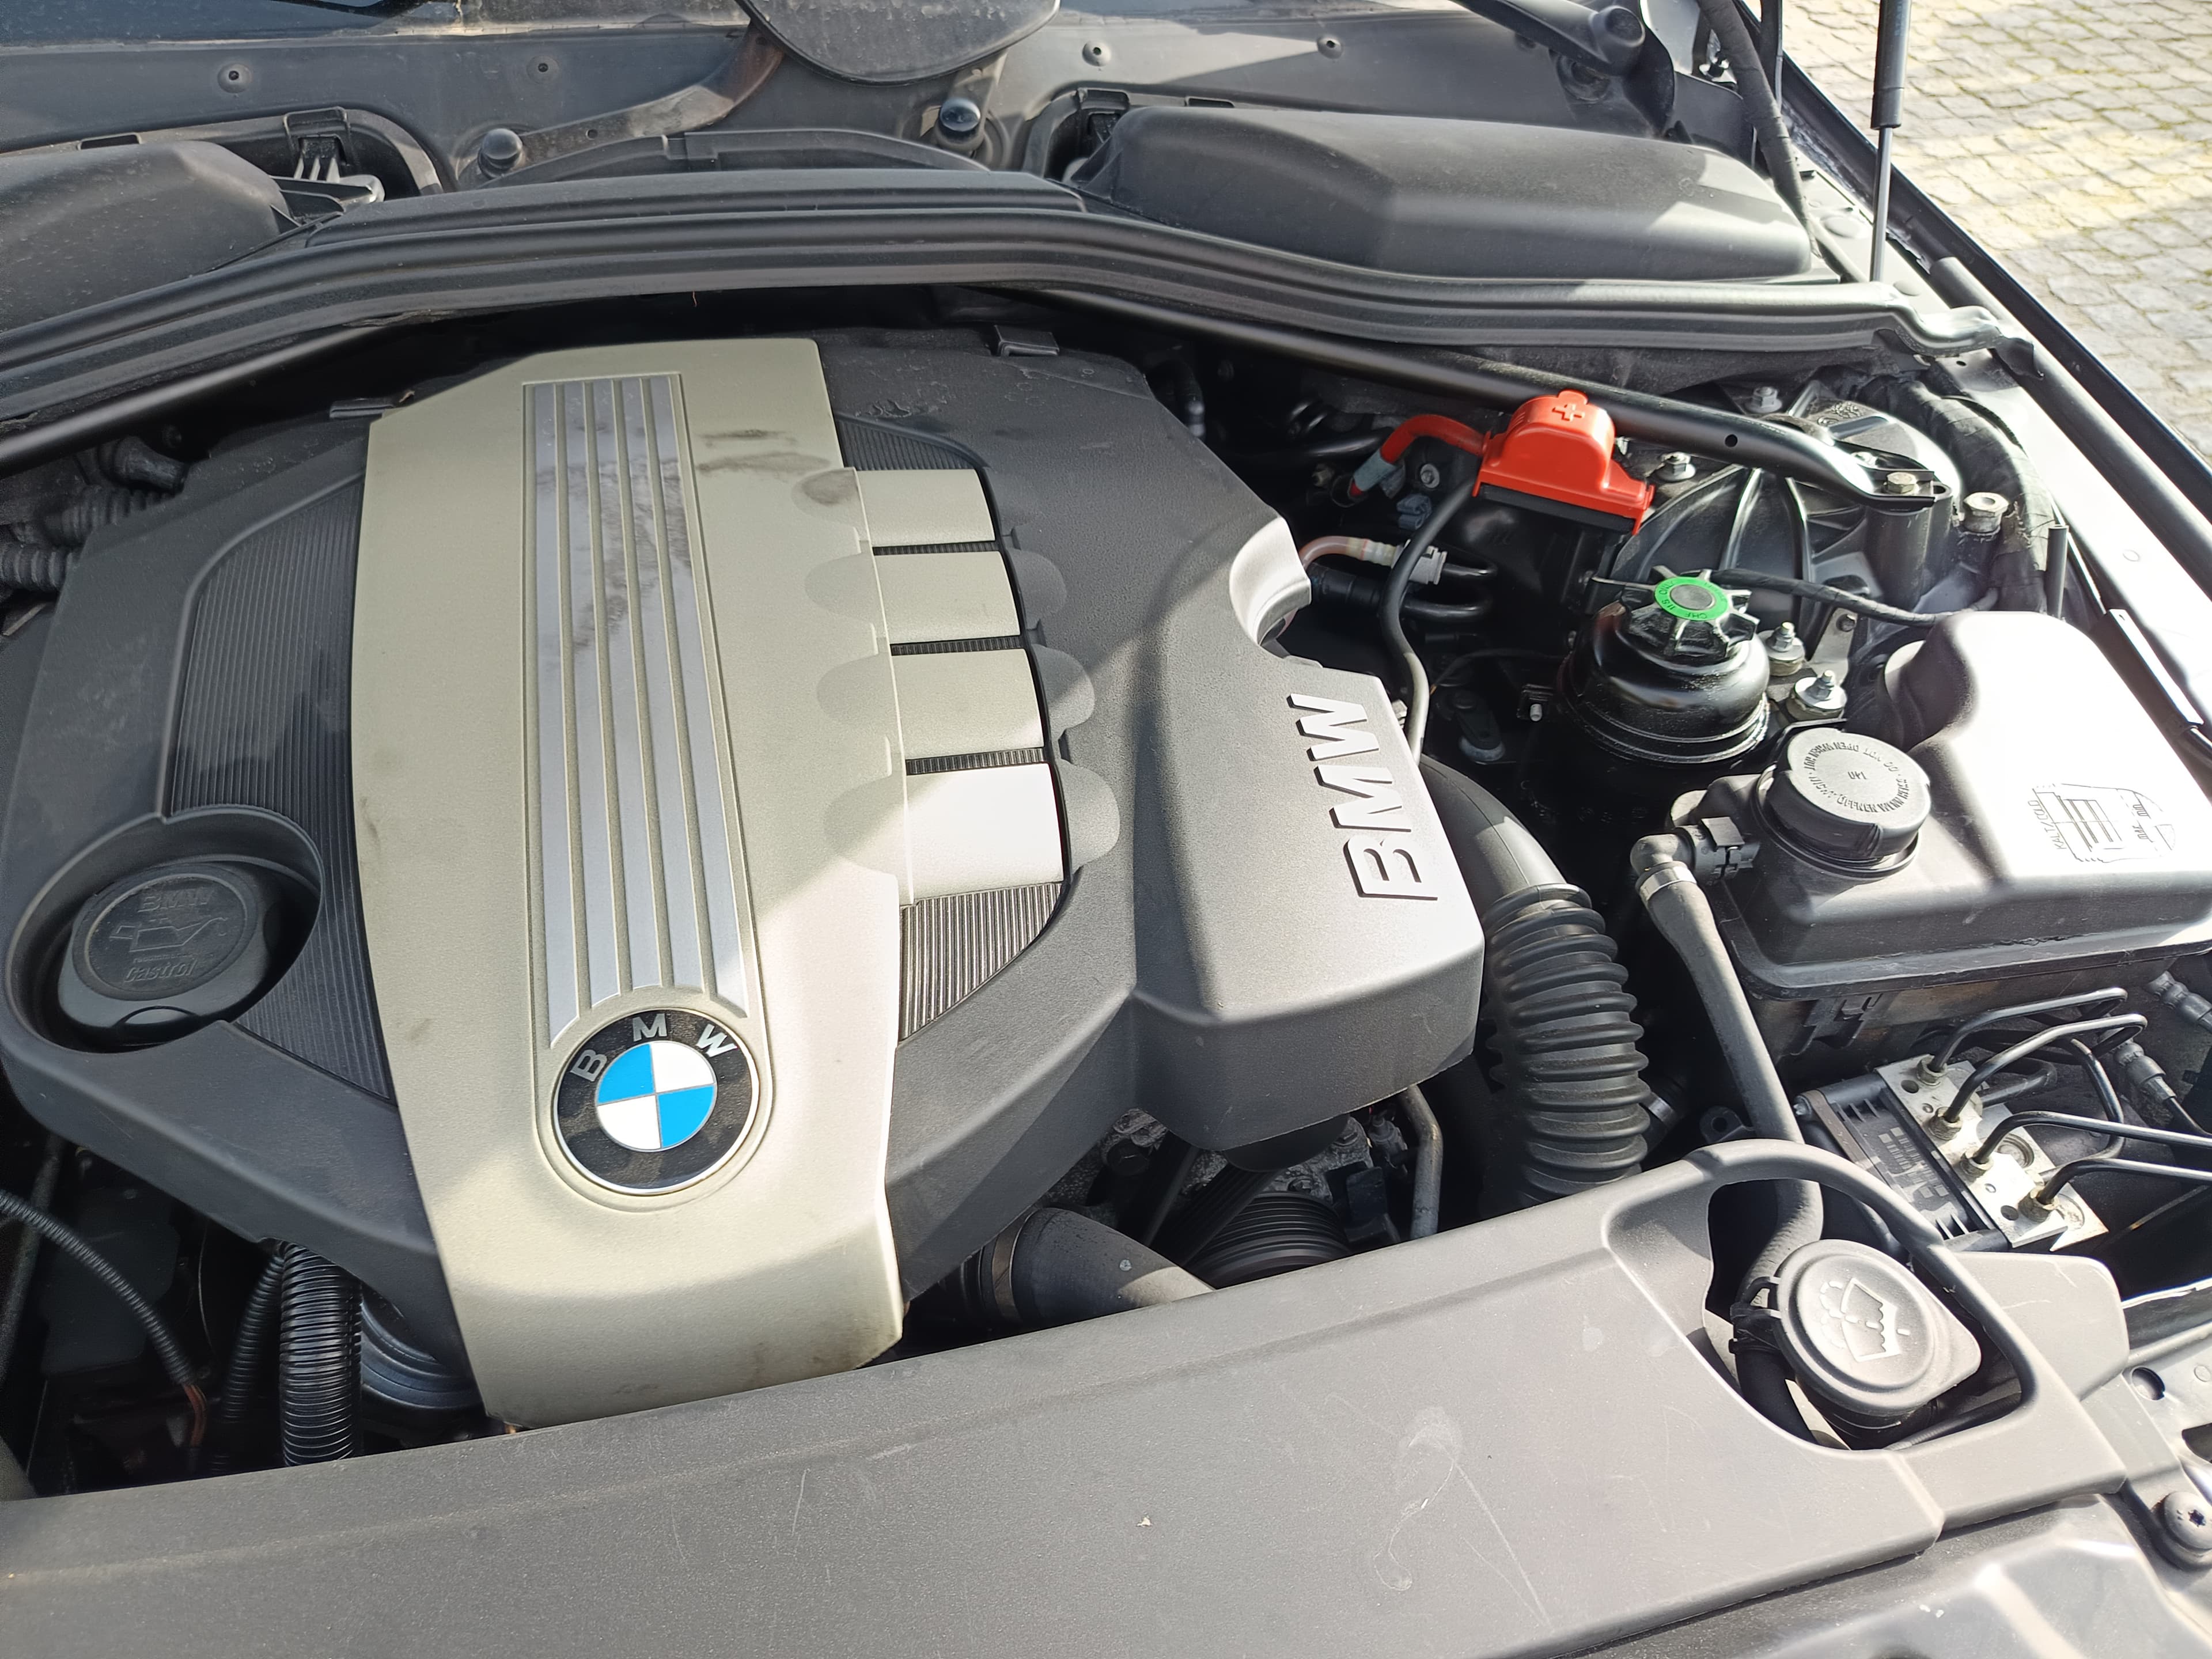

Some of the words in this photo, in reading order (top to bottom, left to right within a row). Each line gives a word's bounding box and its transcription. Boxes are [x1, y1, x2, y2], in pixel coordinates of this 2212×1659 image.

[1658, 580, 1674, 595] ONLY
[1834, 741, 1859, 752] OPEN
[1883, 761, 1899, 772] DO
[1287, 694, 1438, 900] BMW
[1836, 793, 1878, 813] ÖFFNEN
[137, 887, 215, 913] BMW
[123, 957, 199, 984] Castrol
[570, 1013, 737, 1082] BMW
